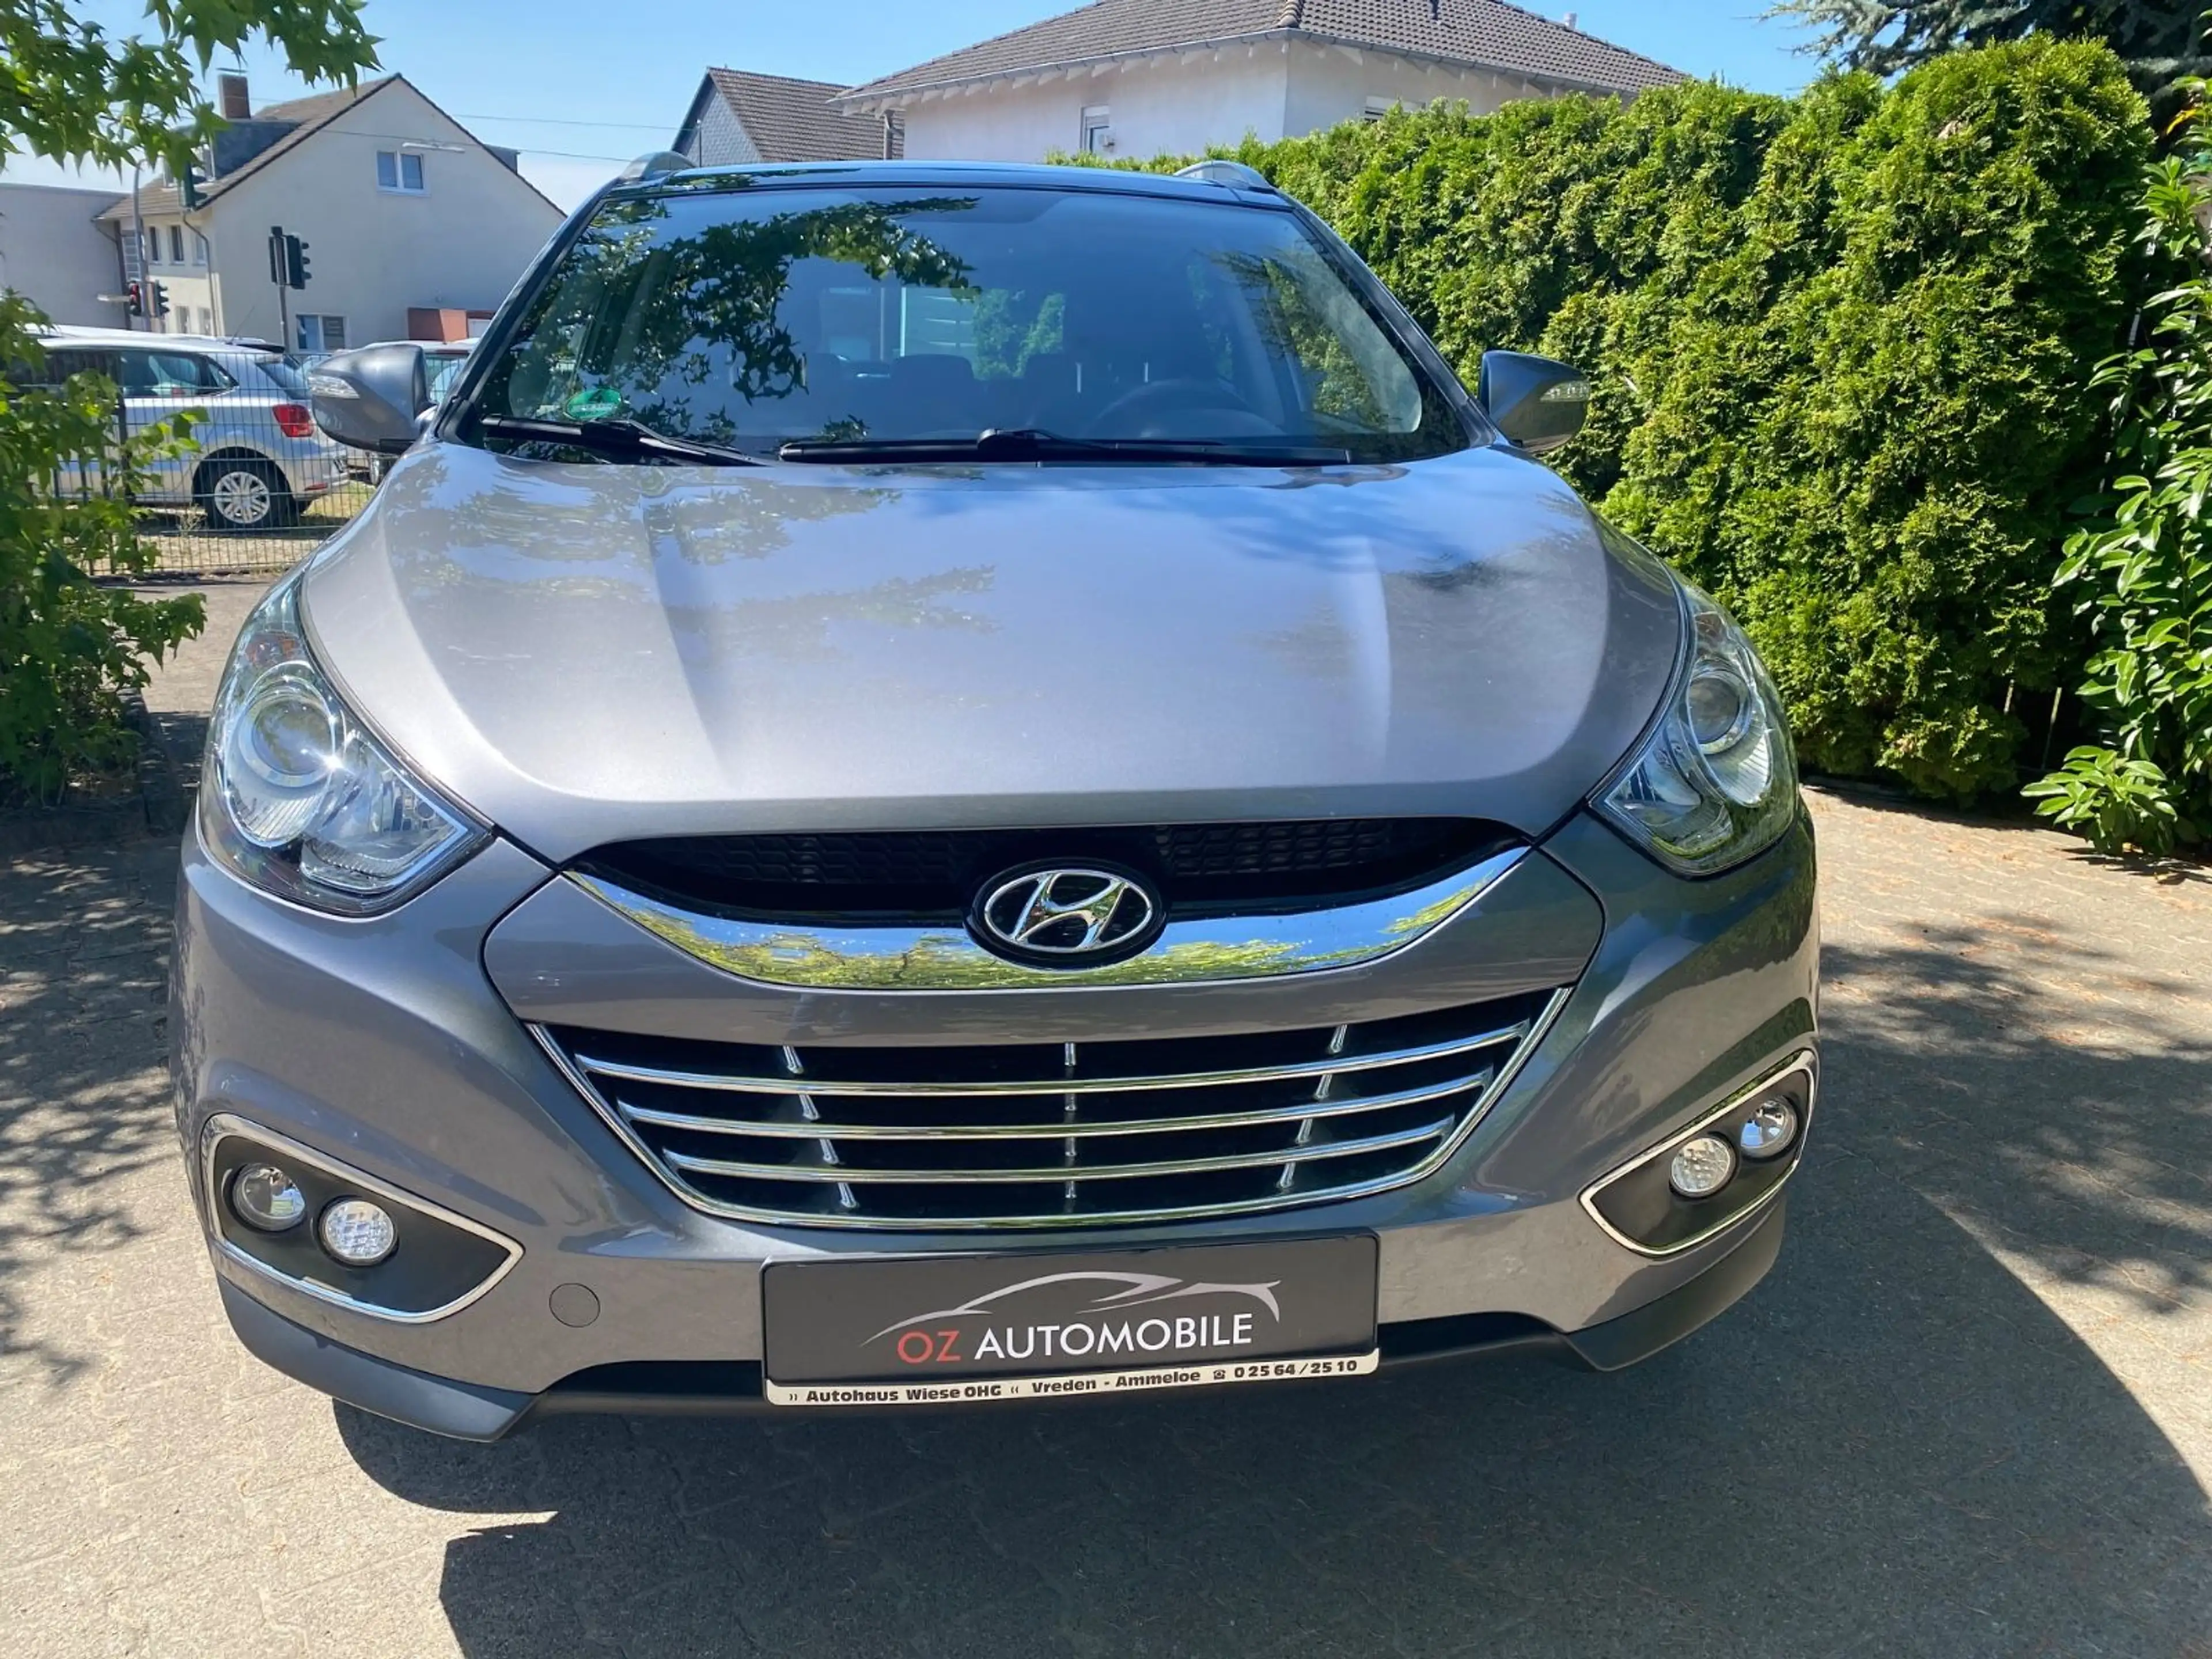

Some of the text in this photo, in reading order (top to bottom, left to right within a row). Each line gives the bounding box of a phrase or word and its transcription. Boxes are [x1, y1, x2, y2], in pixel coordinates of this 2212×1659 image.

[897, 1313, 1253, 1362] OZ AUTOMOBILE
[806, 1390, 899, 1402] Autohaus
[906, 1388, 960, 1400] Wiese
[964, 1385, 1001, 1397] OHG
[1032, 1380, 1097, 1393] Vreden
[1115, 1372, 1201, 1387] Ammeloe
